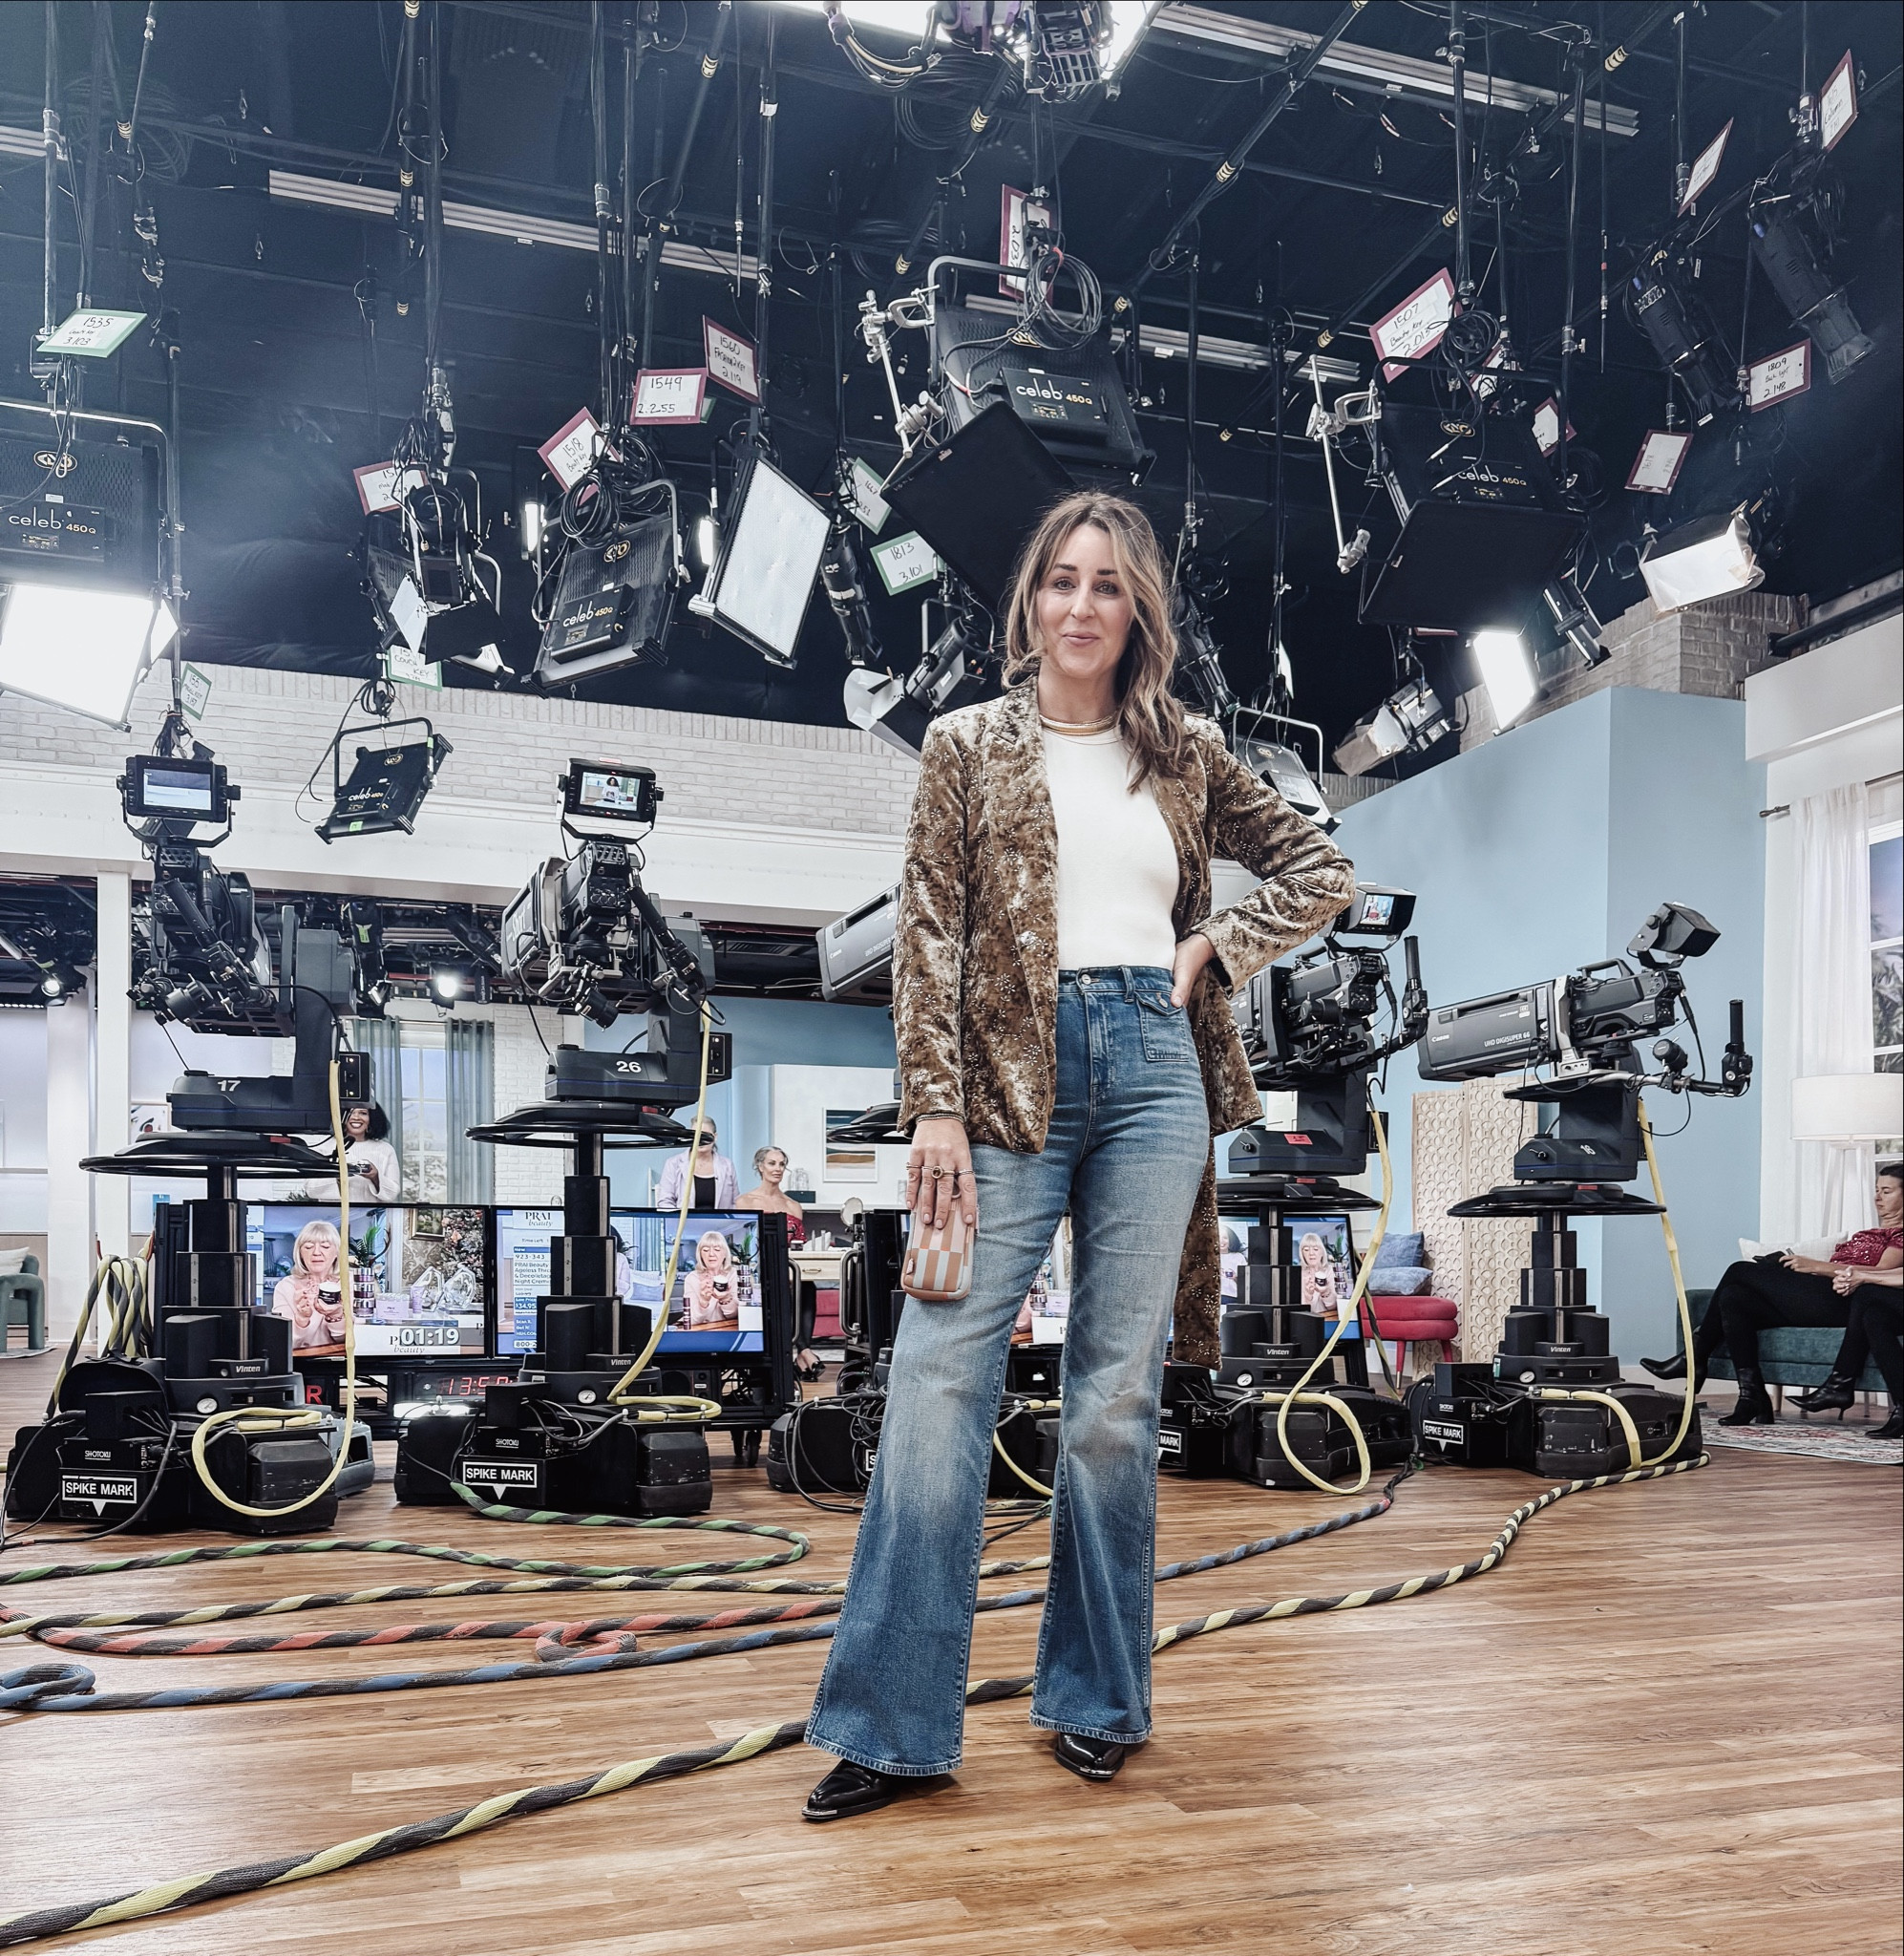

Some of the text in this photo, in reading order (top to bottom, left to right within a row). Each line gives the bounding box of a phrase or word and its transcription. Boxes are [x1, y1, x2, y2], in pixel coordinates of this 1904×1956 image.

[83, 316, 115, 329] 1535
[1393, 302, 1419, 330] 1507
[1767, 357, 1788, 372] 1809
[650, 376, 683, 392] 1549
[1016, 377, 1063, 400] celeb
[562, 436, 584, 458] 1518
[1458, 464, 1499, 483] celeb
[9, 506, 96, 535] celeb 450Q
[890, 542, 915, 561] 1813
[562, 600, 594, 627] celeb
[1431, 1034, 1450, 1043] Canon
[1495, 1032, 1522, 1045] DIGISUPER
[616, 1060, 642, 1073] 26
[217, 1079, 242, 1092] 17
[525, 1211, 551, 1222] PRAI
[528, 1219, 554, 1228] beauty
[400, 1328, 459, 1347] 01:19
[393, 1345, 426, 1354] beauty
[235, 1364, 262, 1373] Vinten
[611, 1358, 632, 1367] Vinten
[1425, 1424, 1462, 1439] SPIKE MARK
[1159, 1434, 1179, 1448] MARK
[84, 1450, 112, 1458] SHOTOKU
[466, 1468, 534, 1481] SPIKE MARK
[65, 1480, 134, 1497] SPIKE MARK
